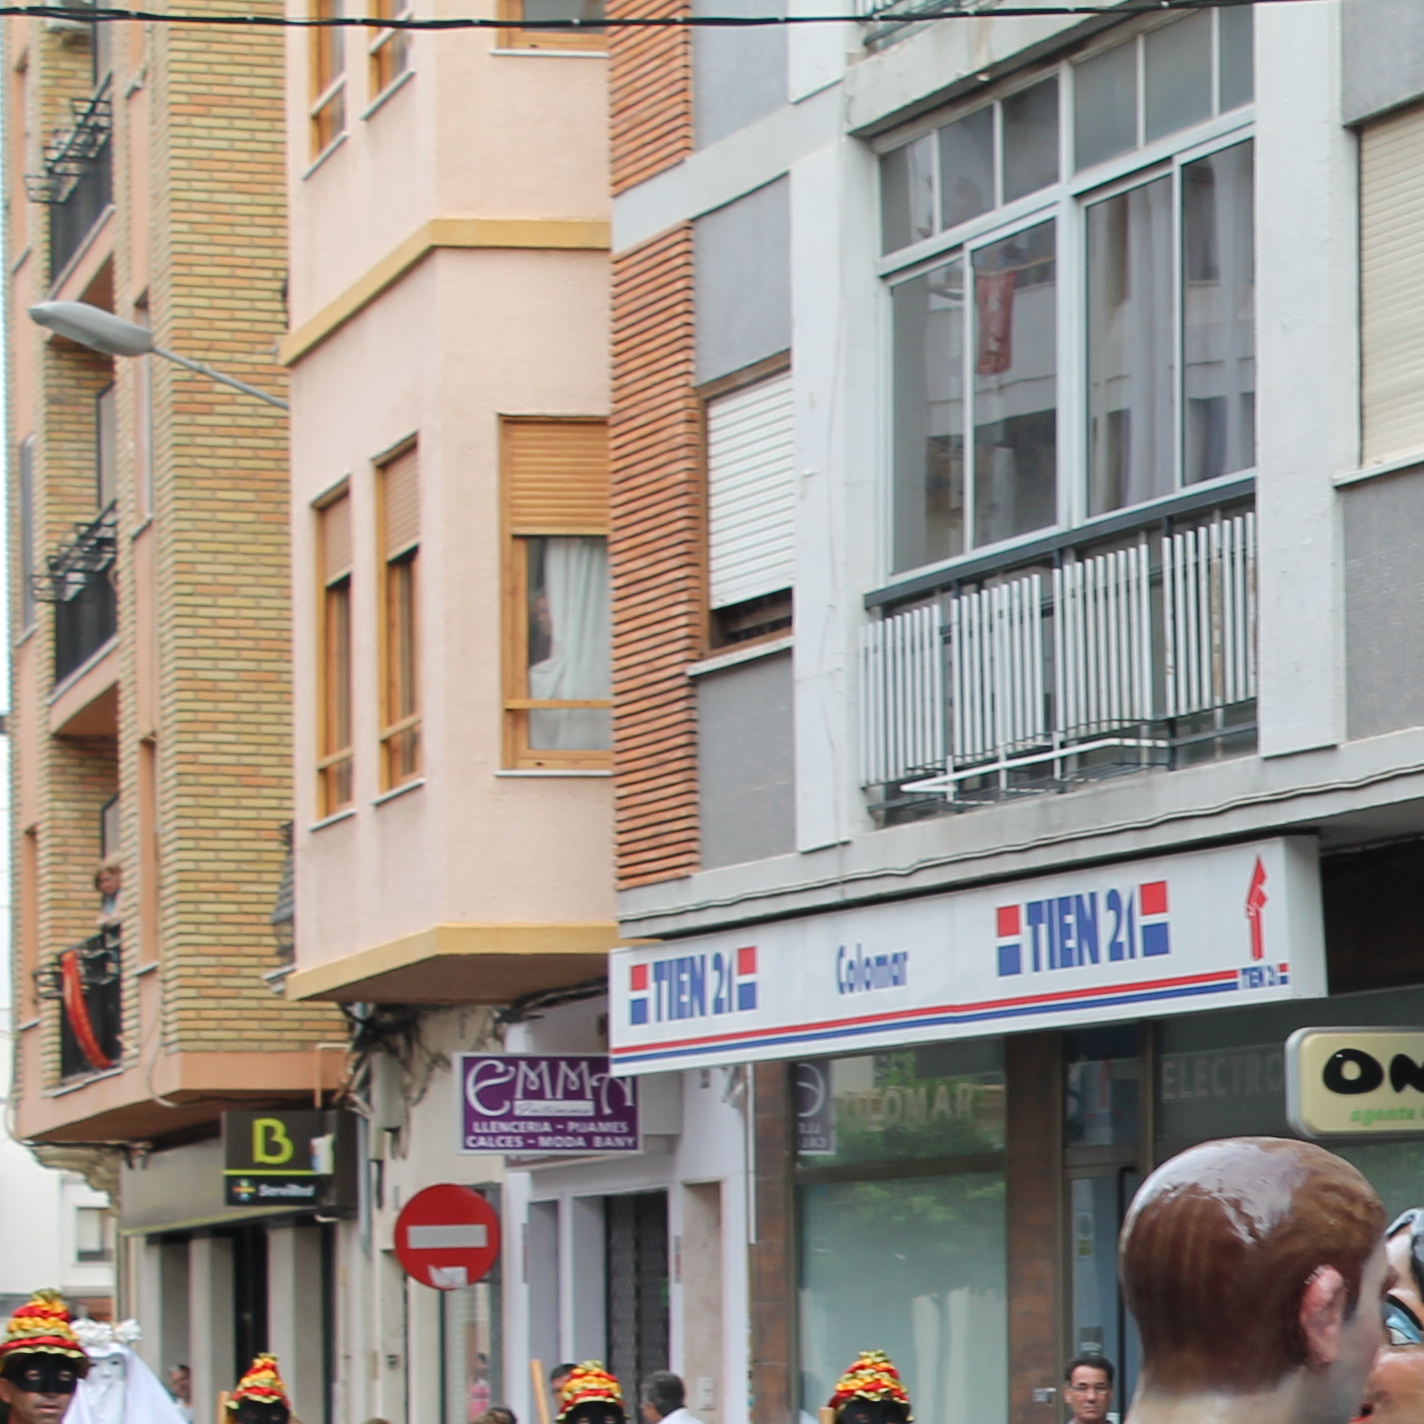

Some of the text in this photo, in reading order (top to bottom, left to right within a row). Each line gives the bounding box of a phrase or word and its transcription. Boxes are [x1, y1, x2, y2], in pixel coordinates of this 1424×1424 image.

[1026, 886, 1136, 973] TIEN 21
[653, 951, 733, 1023] TIEN 21
[837, 943, 909, 996] Colomar
[466, 1060, 634, 1117] EMMA
[253, 1117, 294, 1164] B
[466, 1135, 524, 1148] CALCES
[538, 1135, 587, 1148] MODA
[593, 1136, 636, 1148] BANY
[1350, 1106, 1415, 1126] agente
